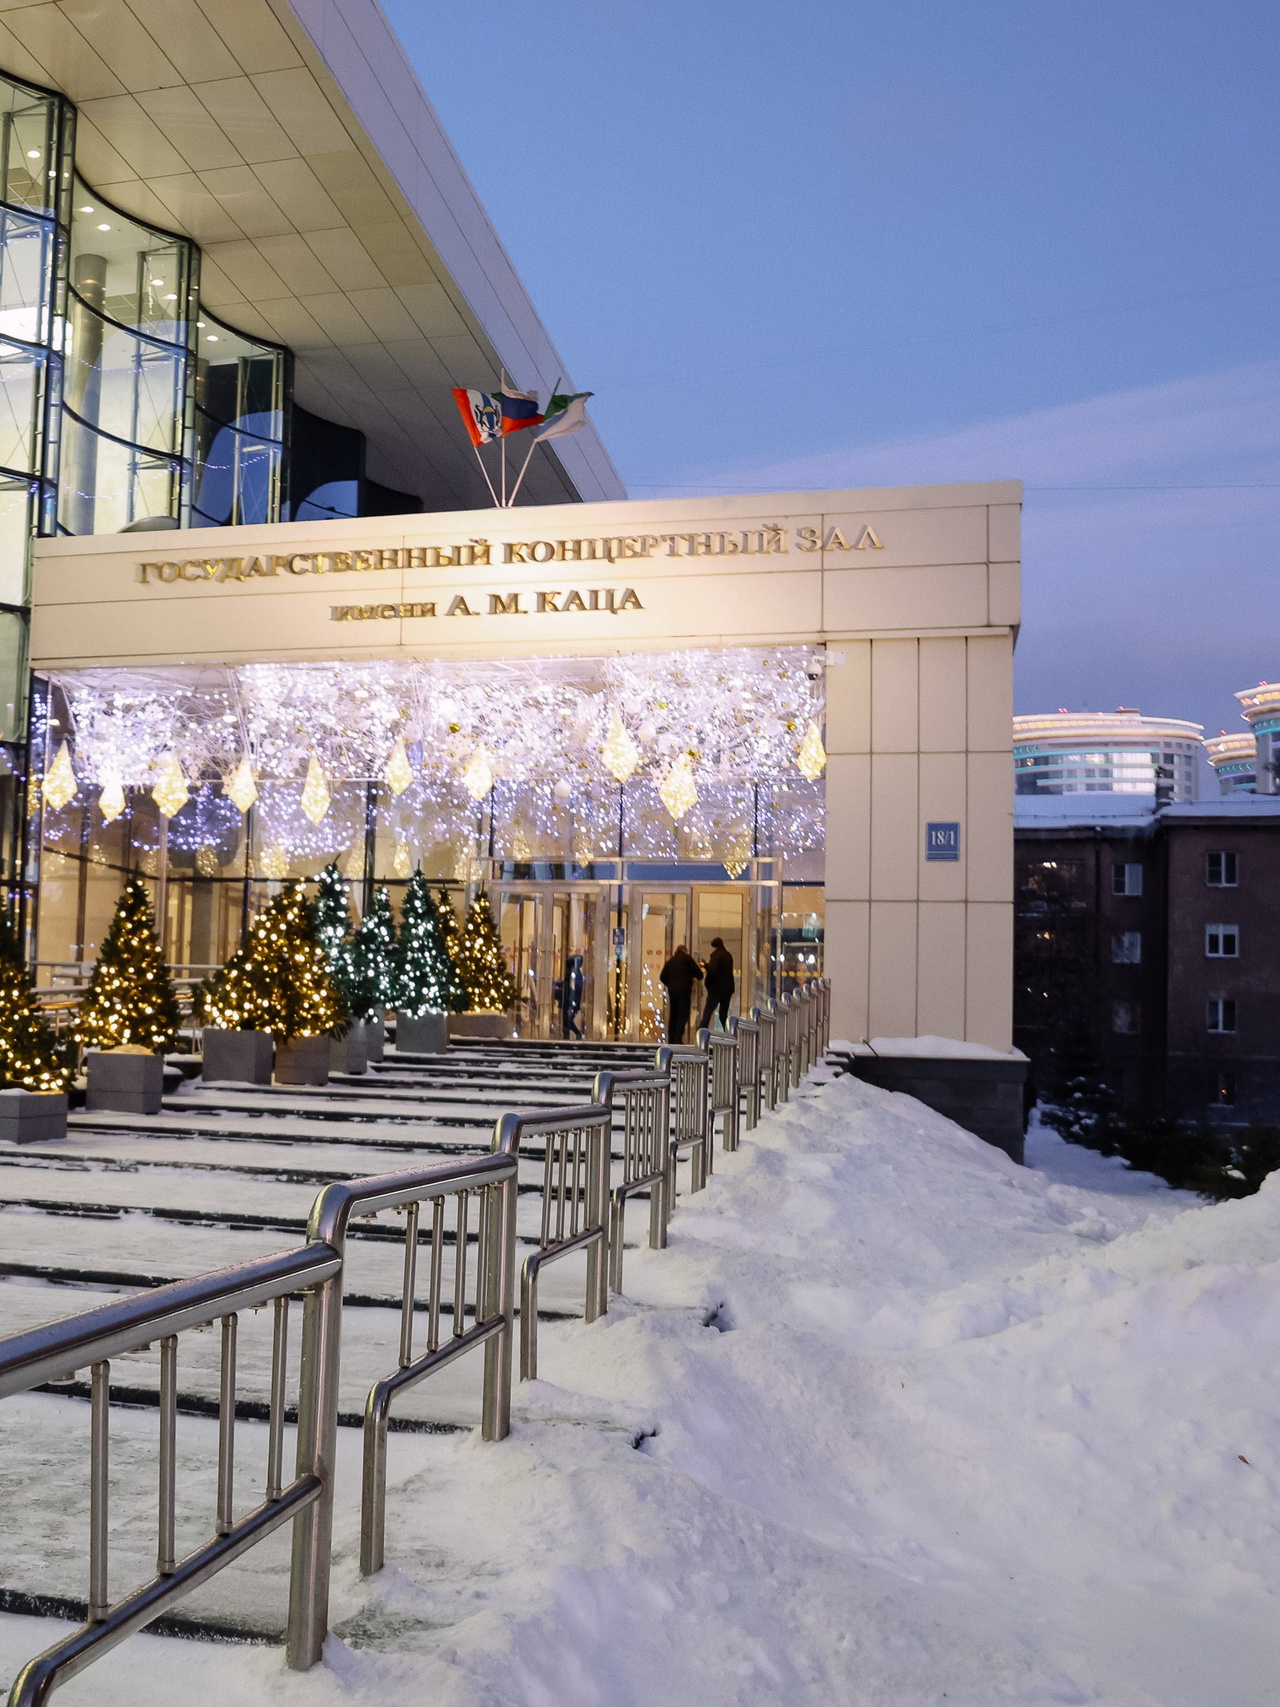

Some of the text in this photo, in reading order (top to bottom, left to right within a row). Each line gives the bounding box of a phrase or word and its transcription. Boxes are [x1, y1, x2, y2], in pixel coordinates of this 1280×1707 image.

[138, 523, 885, 584] ГОСУДАРСТВЕННЫЙ КОНЦЕРТНЫЙ ЗАЛ
[329, 587, 646, 622] имени А. М. КАЦА
[931, 830, 955, 846] 18/1
